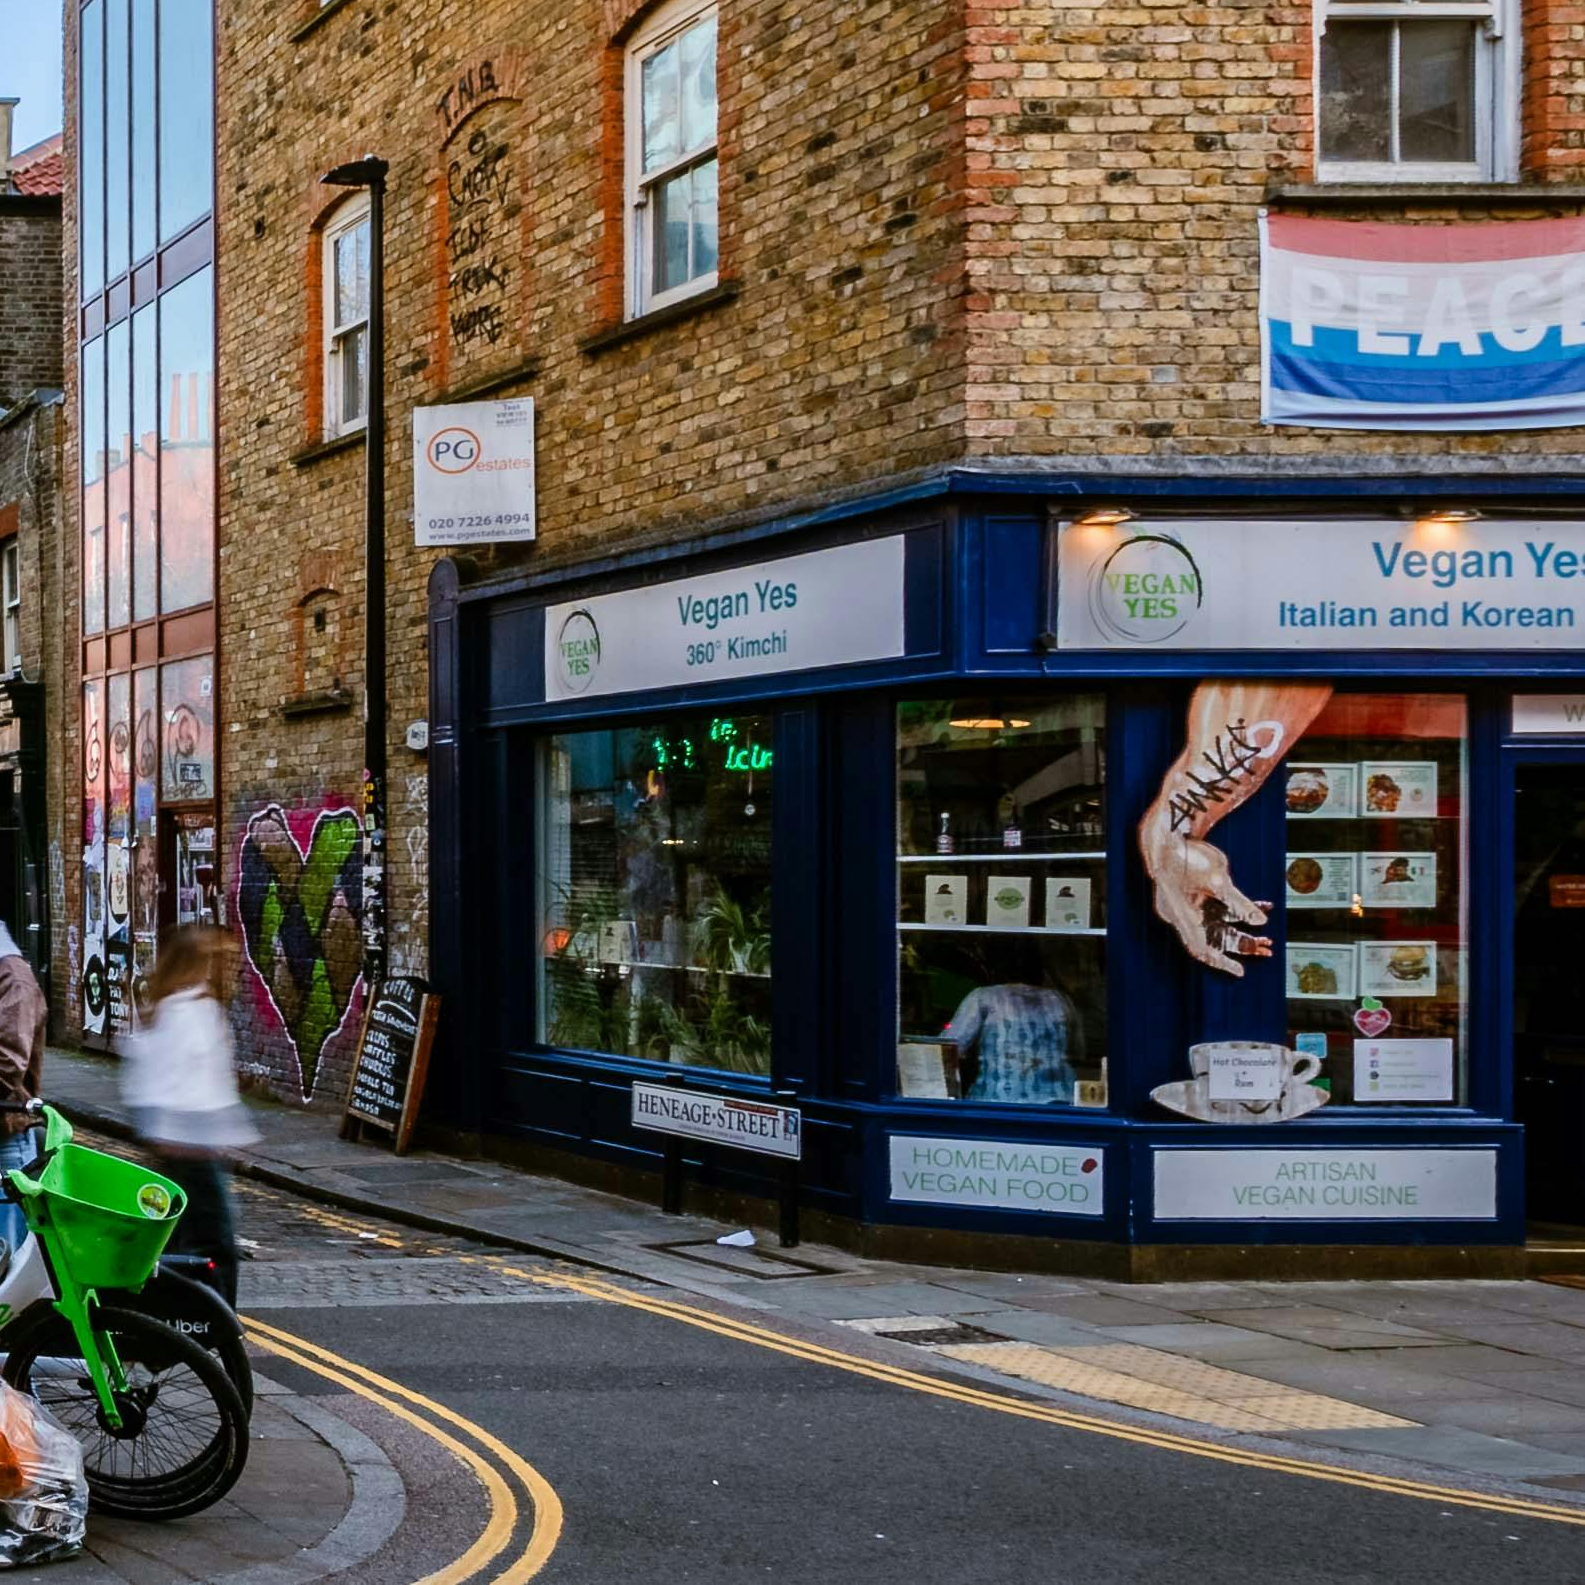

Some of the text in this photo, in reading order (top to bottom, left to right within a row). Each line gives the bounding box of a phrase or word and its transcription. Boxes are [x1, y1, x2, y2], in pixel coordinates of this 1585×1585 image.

[435, 439, 474, 462] PG
[476, 456, 532, 473] estates
[429, 513, 530, 530] 020 7226 4994
[1370, 541, 1513, 589] Vegan
[1106, 573, 1196, 595] VEGAN
[677, 579, 798, 630] Vegan Yes
[1123, 598, 1178, 619] YES
[1278, 601, 1575, 627] Italian and Korean
[560, 637, 599, 662] VEGAN
[728, 629, 787, 660] Kimchi
[566, 657, 591, 676] YES
[638, 1092, 711, 1126] HENEAGE
[717, 1107, 780, 1139] STREET
[912, 1146, 1079, 1177] HOMEMADE
[1275, 1161, 1377, 1182] ARTISAN
[902, 1171, 1089, 1204] VEGAN FOOD
[1233, 1185, 1419, 1208] VEGAN CUISINE
